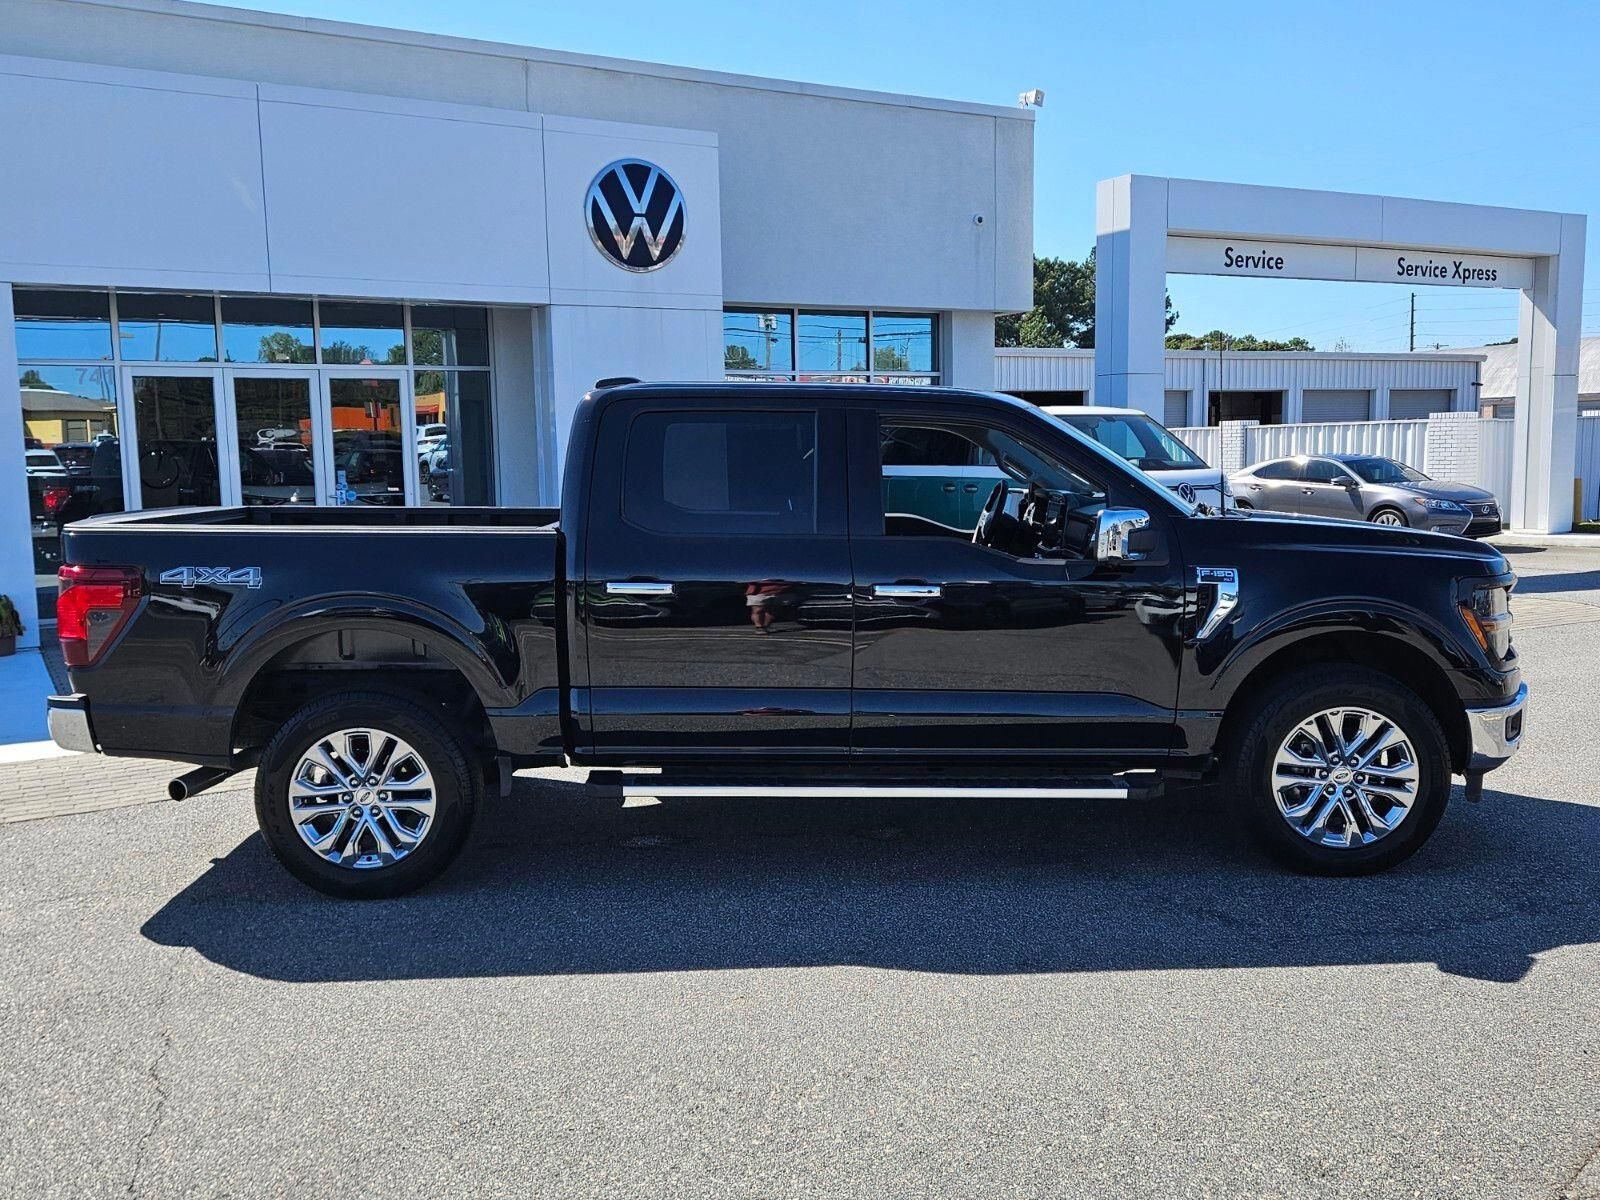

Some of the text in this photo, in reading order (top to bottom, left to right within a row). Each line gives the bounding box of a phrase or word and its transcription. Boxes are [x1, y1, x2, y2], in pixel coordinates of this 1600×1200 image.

[586, 159, 687, 271] VW
[1224, 247, 1284, 270] Service
[1397, 257, 1498, 284] Service Xpress
